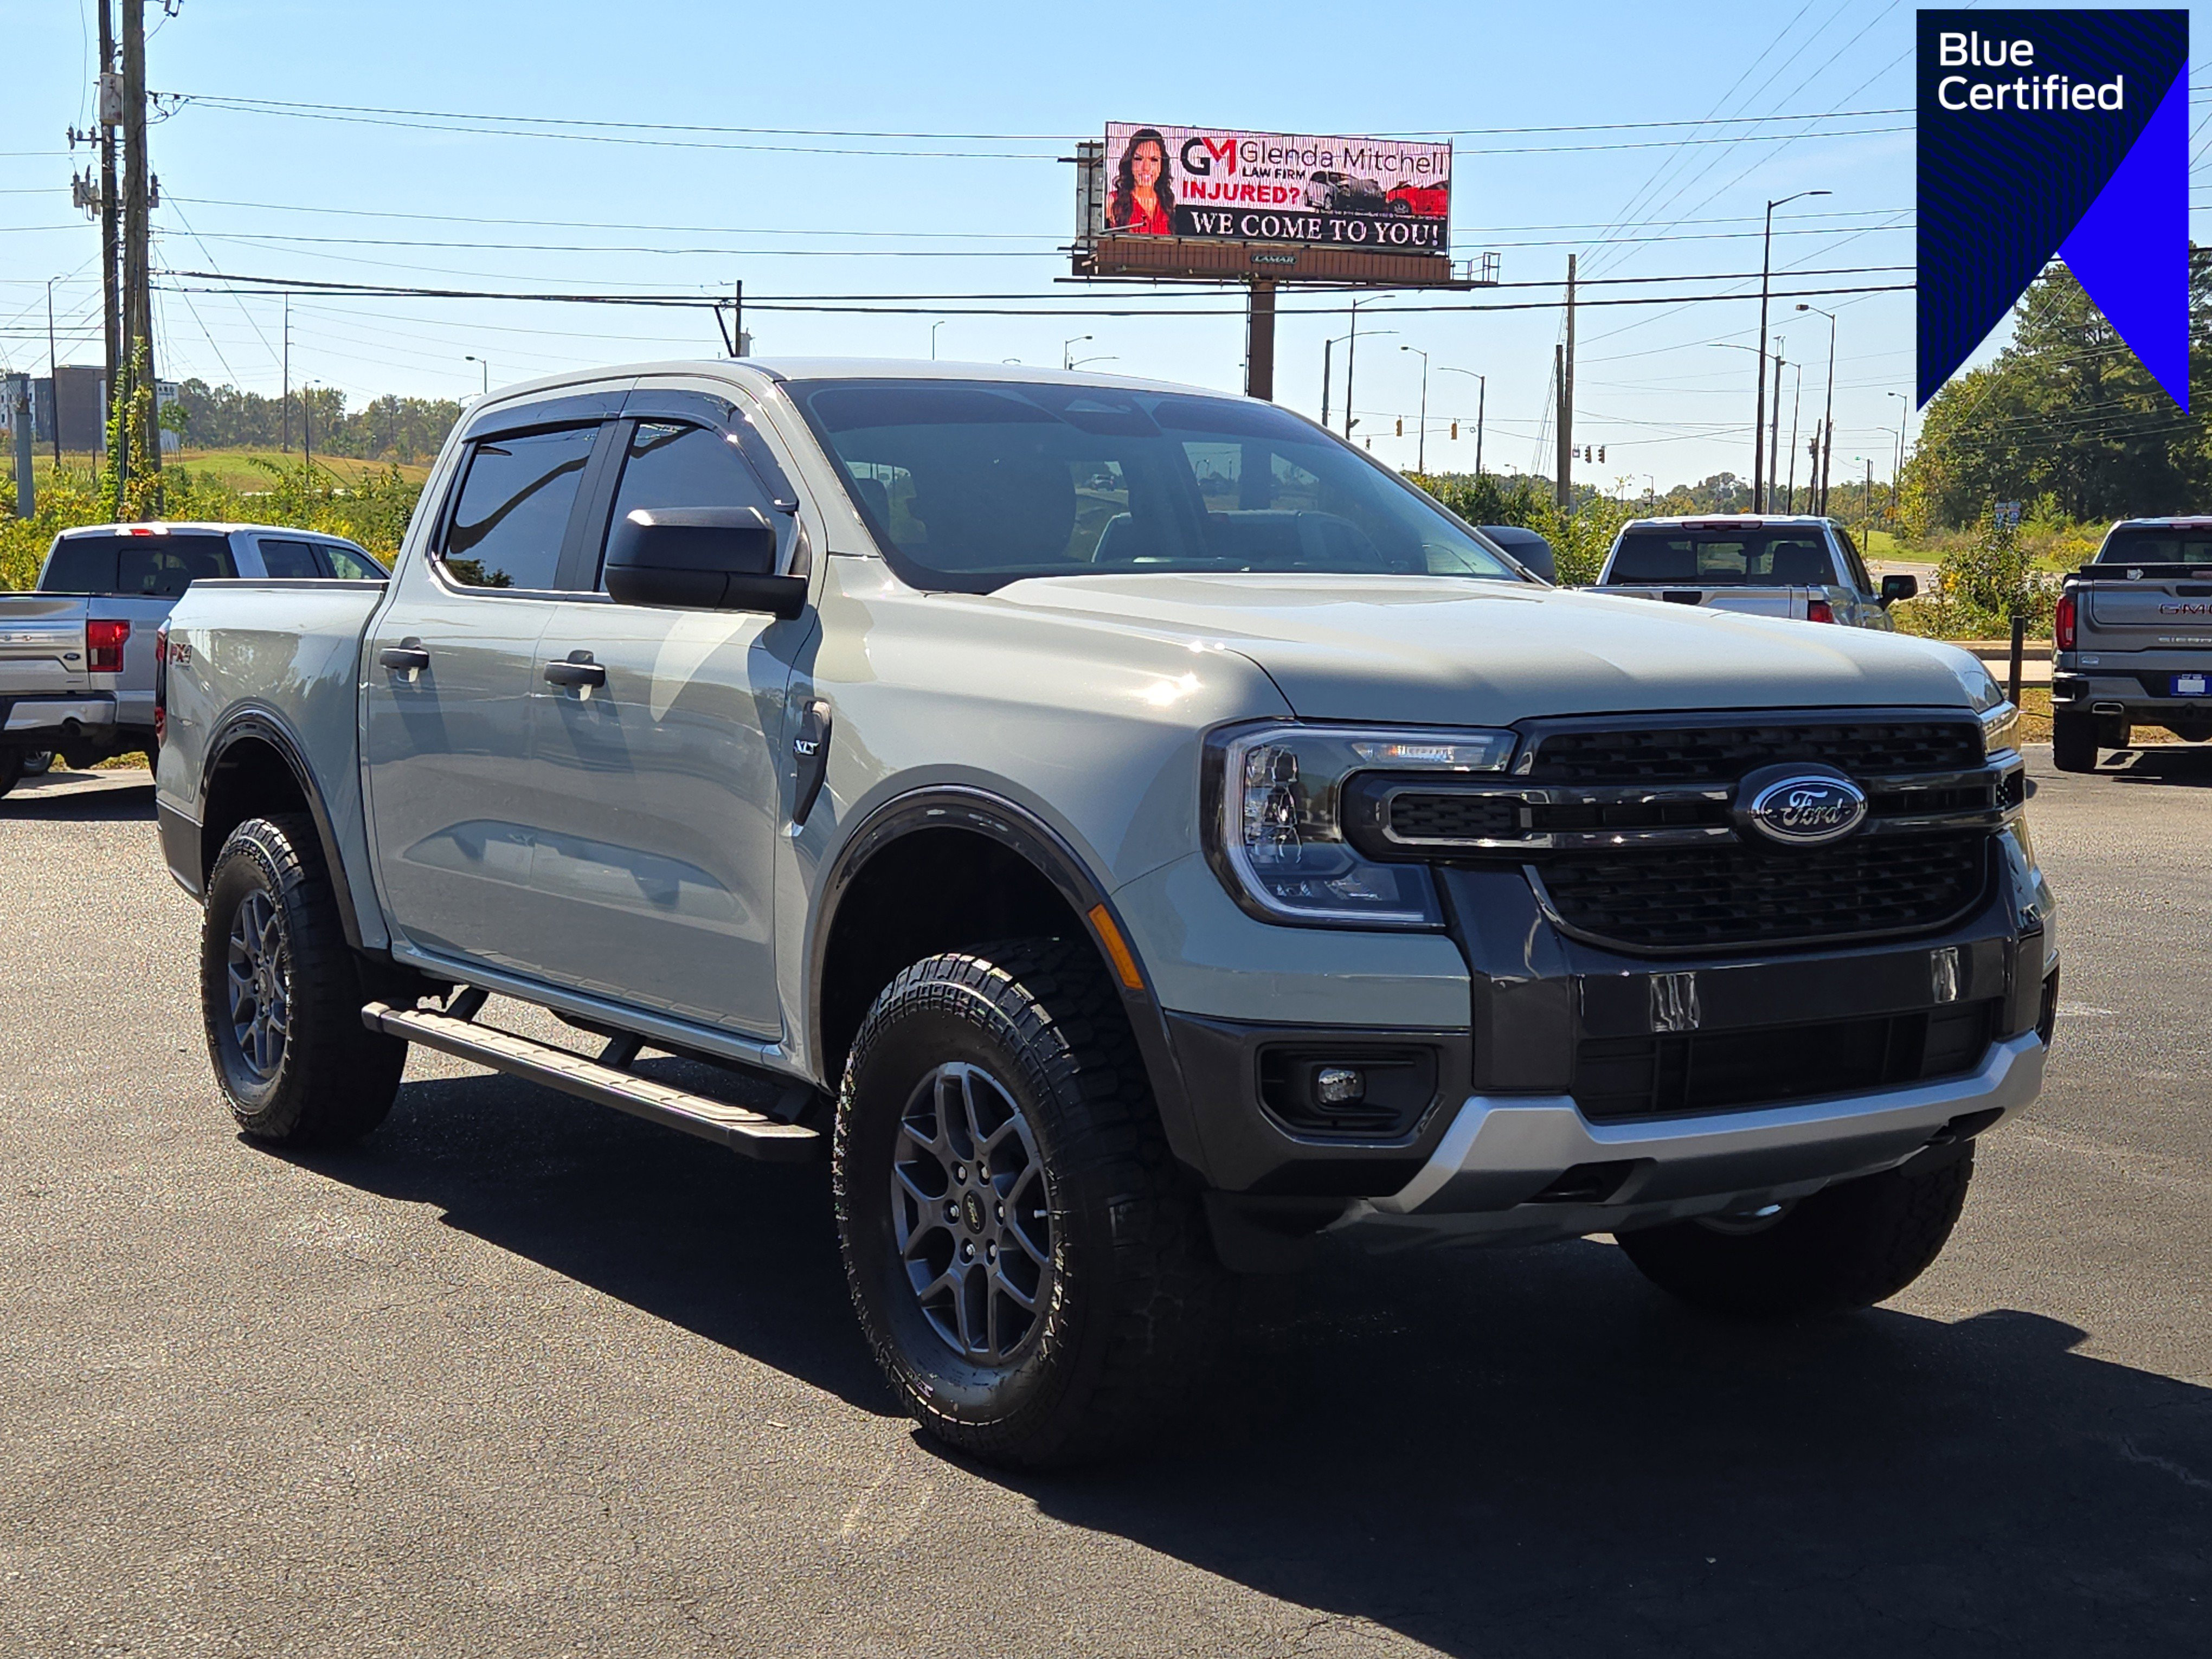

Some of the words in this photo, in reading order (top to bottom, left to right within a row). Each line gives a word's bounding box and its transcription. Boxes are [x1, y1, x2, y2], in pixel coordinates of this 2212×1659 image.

[1240, 140, 1333, 168] Glenda
[1344, 147, 1443, 175] Mitchell
[1242, 166, 1272, 177] LAW
[1275, 168, 1306, 180] FIRM
[1183, 181, 1300, 204] INJURED?
[1191, 211, 1234, 234] WE
[1241, 215, 1322, 240] COME
[1329, 219, 1367, 242] TO
[1374, 221, 1438, 246] YOU!
[1255, 255, 1294, 263] LAMAR
[2159, 603, 2212, 615] GM
[1780, 790, 1844, 826] Ford
